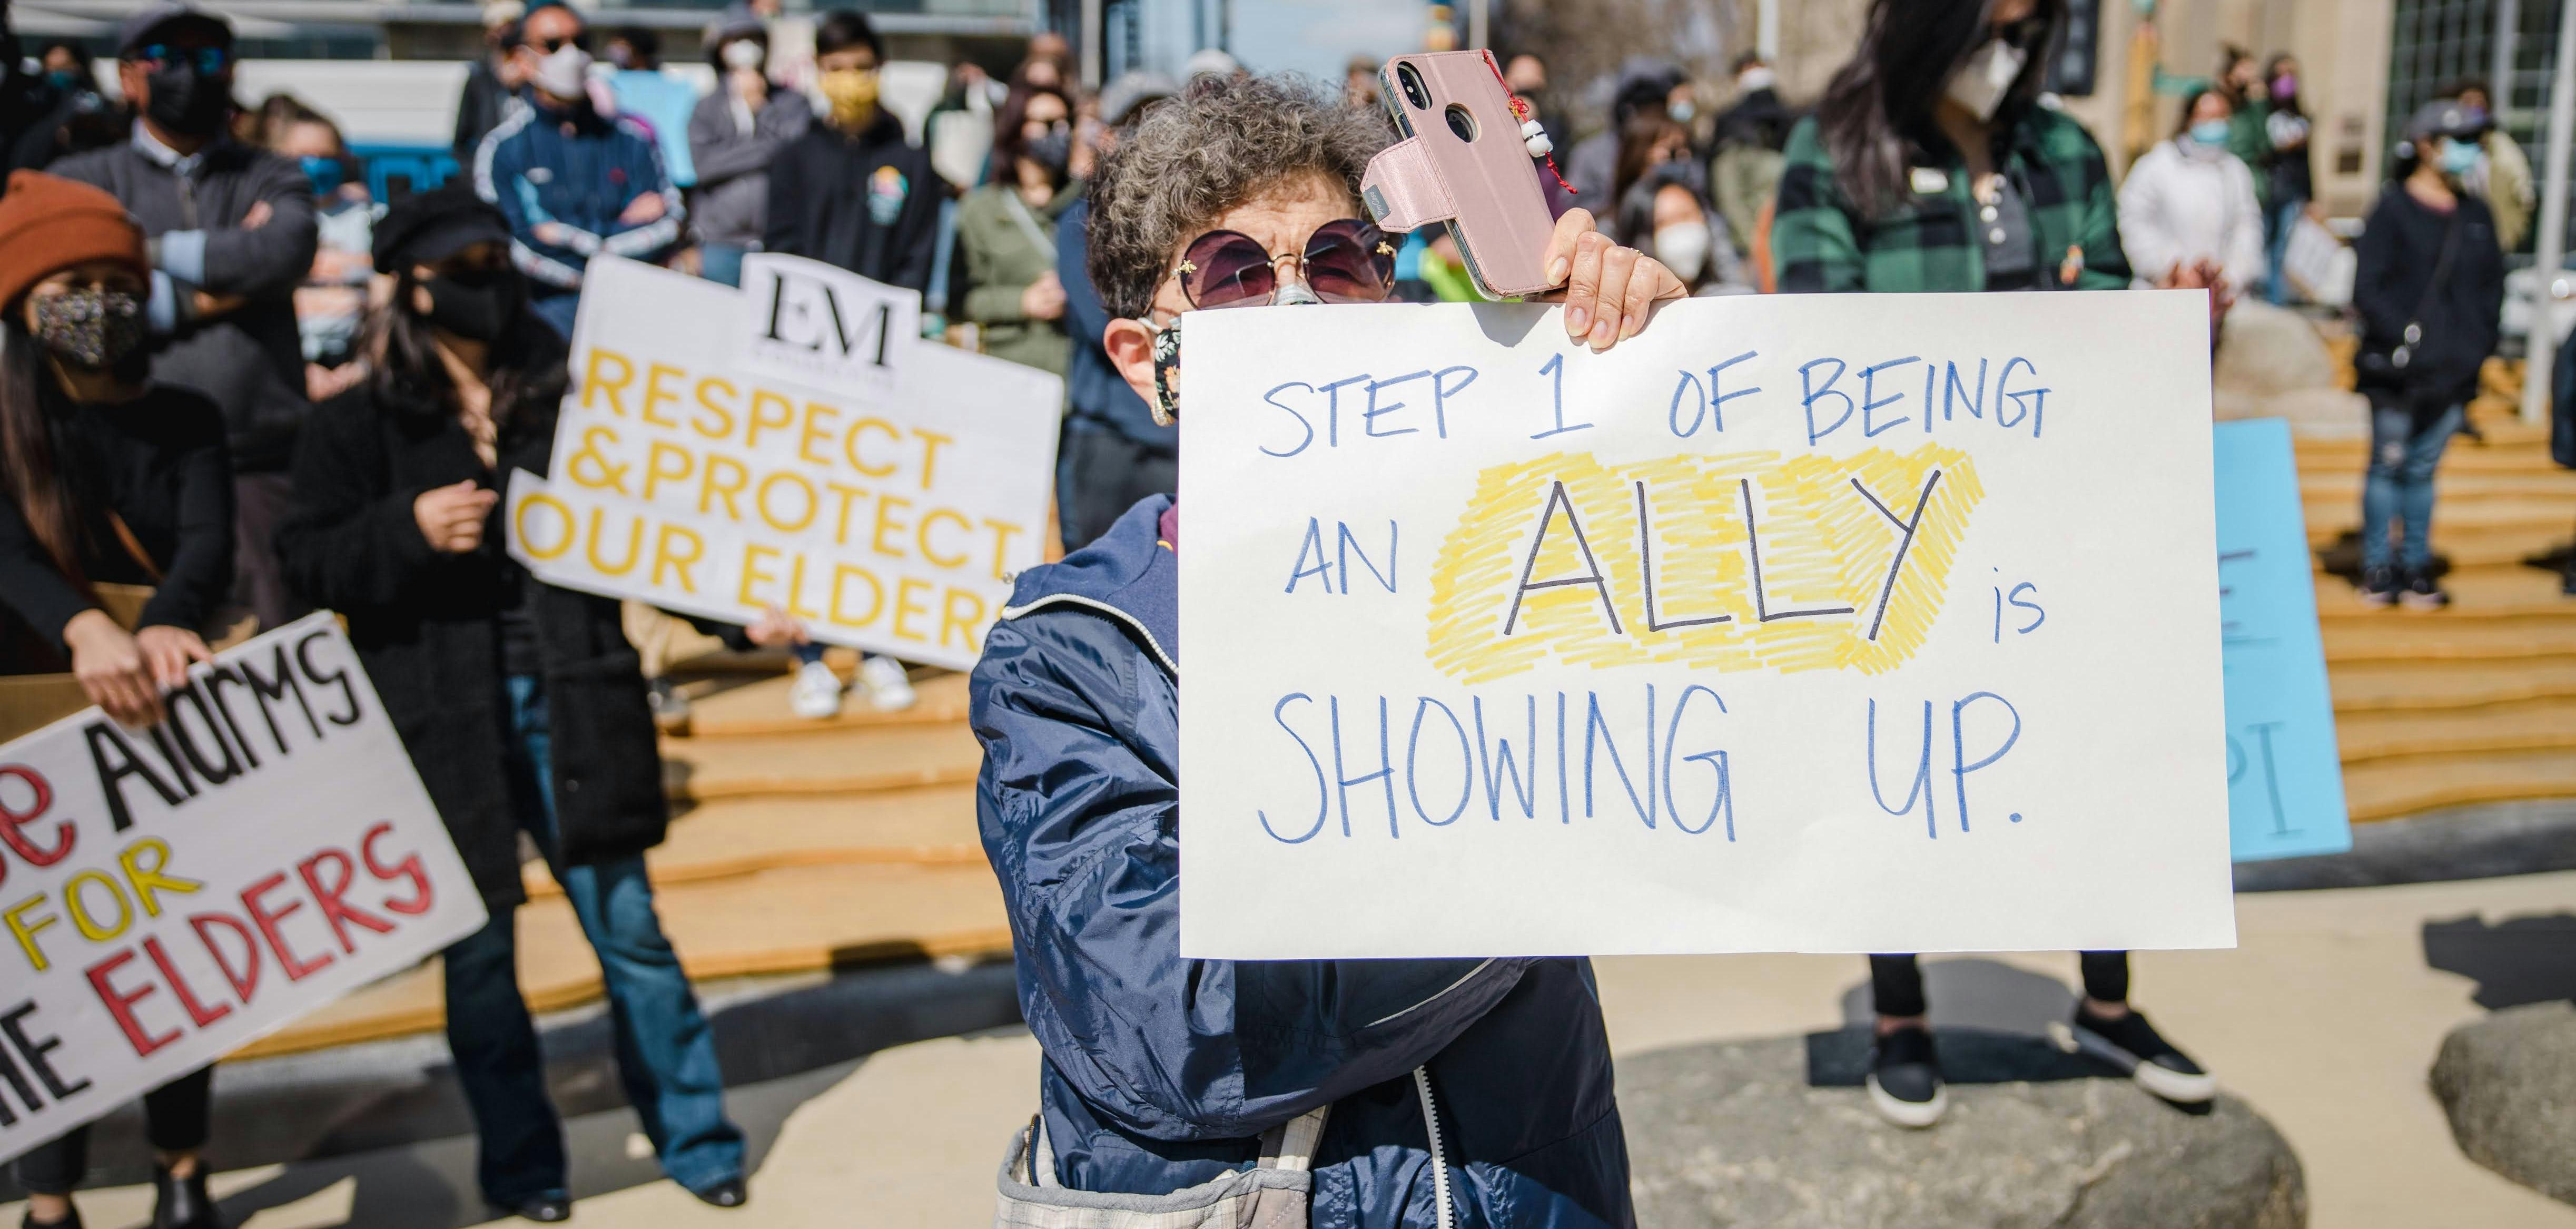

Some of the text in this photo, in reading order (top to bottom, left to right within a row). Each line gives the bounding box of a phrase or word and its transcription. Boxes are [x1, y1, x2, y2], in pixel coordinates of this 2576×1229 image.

[760, 271, 896, 370] EM
[580, 347, 953, 490] RESPECT
[1258, 350, 2052, 457] STEP 1 OF BEING
[514, 491, 1004, 654] OUR ELDER
[566, 425, 1023, 581] &PROTECT
[1284, 469, 2046, 644] AN ALLY is
[0, 765, 76, 887] e
[1257, 683, 2024, 845] SHOWING UP.
[3, 837, 203, 974] FOR
[85, 821, 435, 1058] ELDERS
